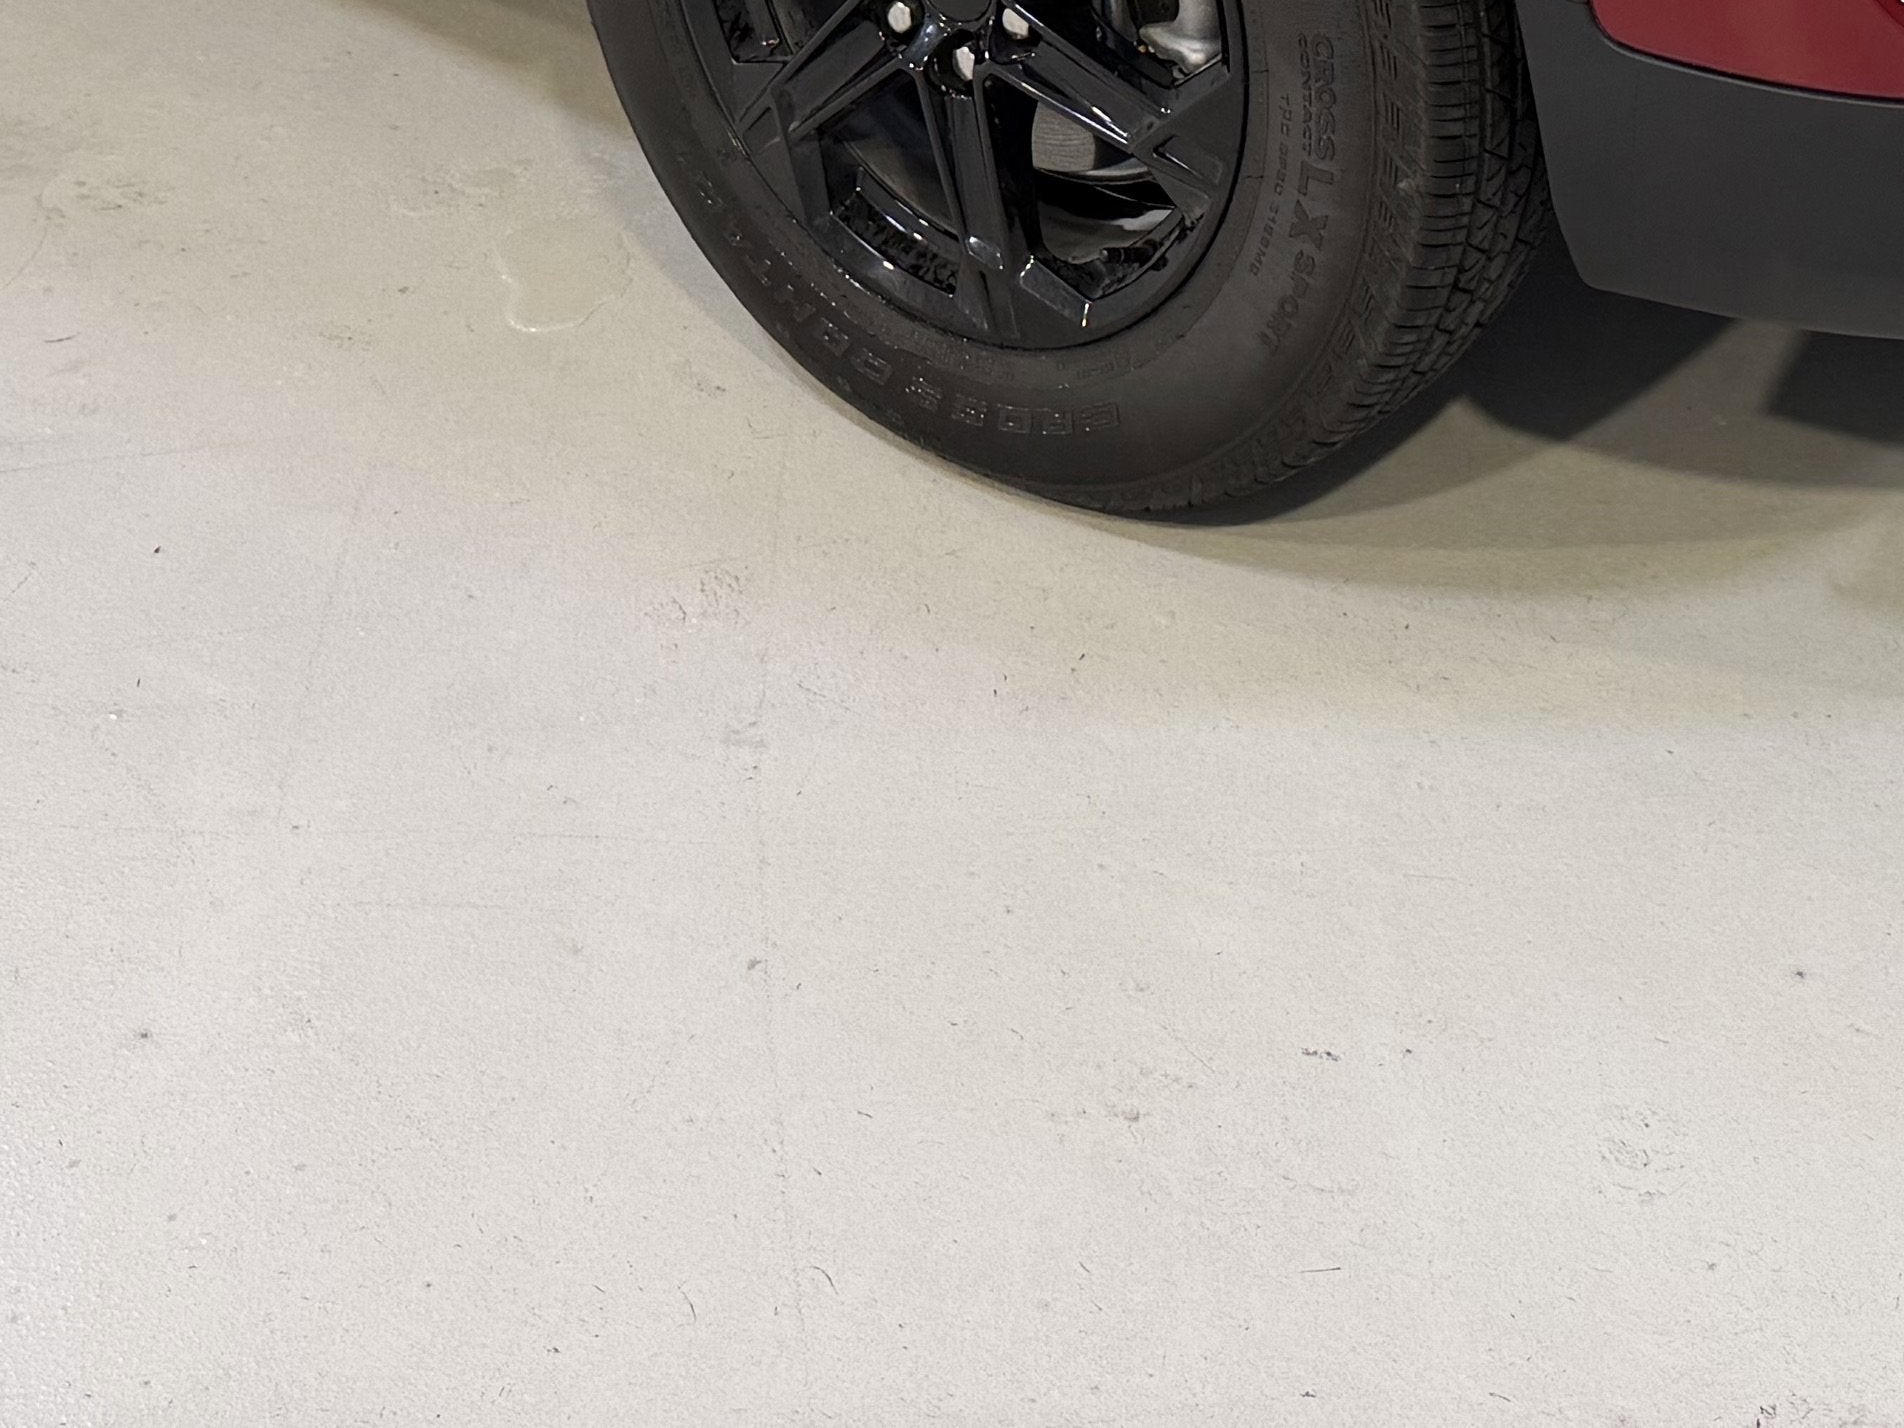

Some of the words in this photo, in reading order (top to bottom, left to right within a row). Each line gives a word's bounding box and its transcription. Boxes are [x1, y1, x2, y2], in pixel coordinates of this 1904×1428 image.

[1297, 31, 1313, 158] CONTACT
[1310, 31, 1337, 162] CROSS
[1288, 159, 1335, 252] LX
